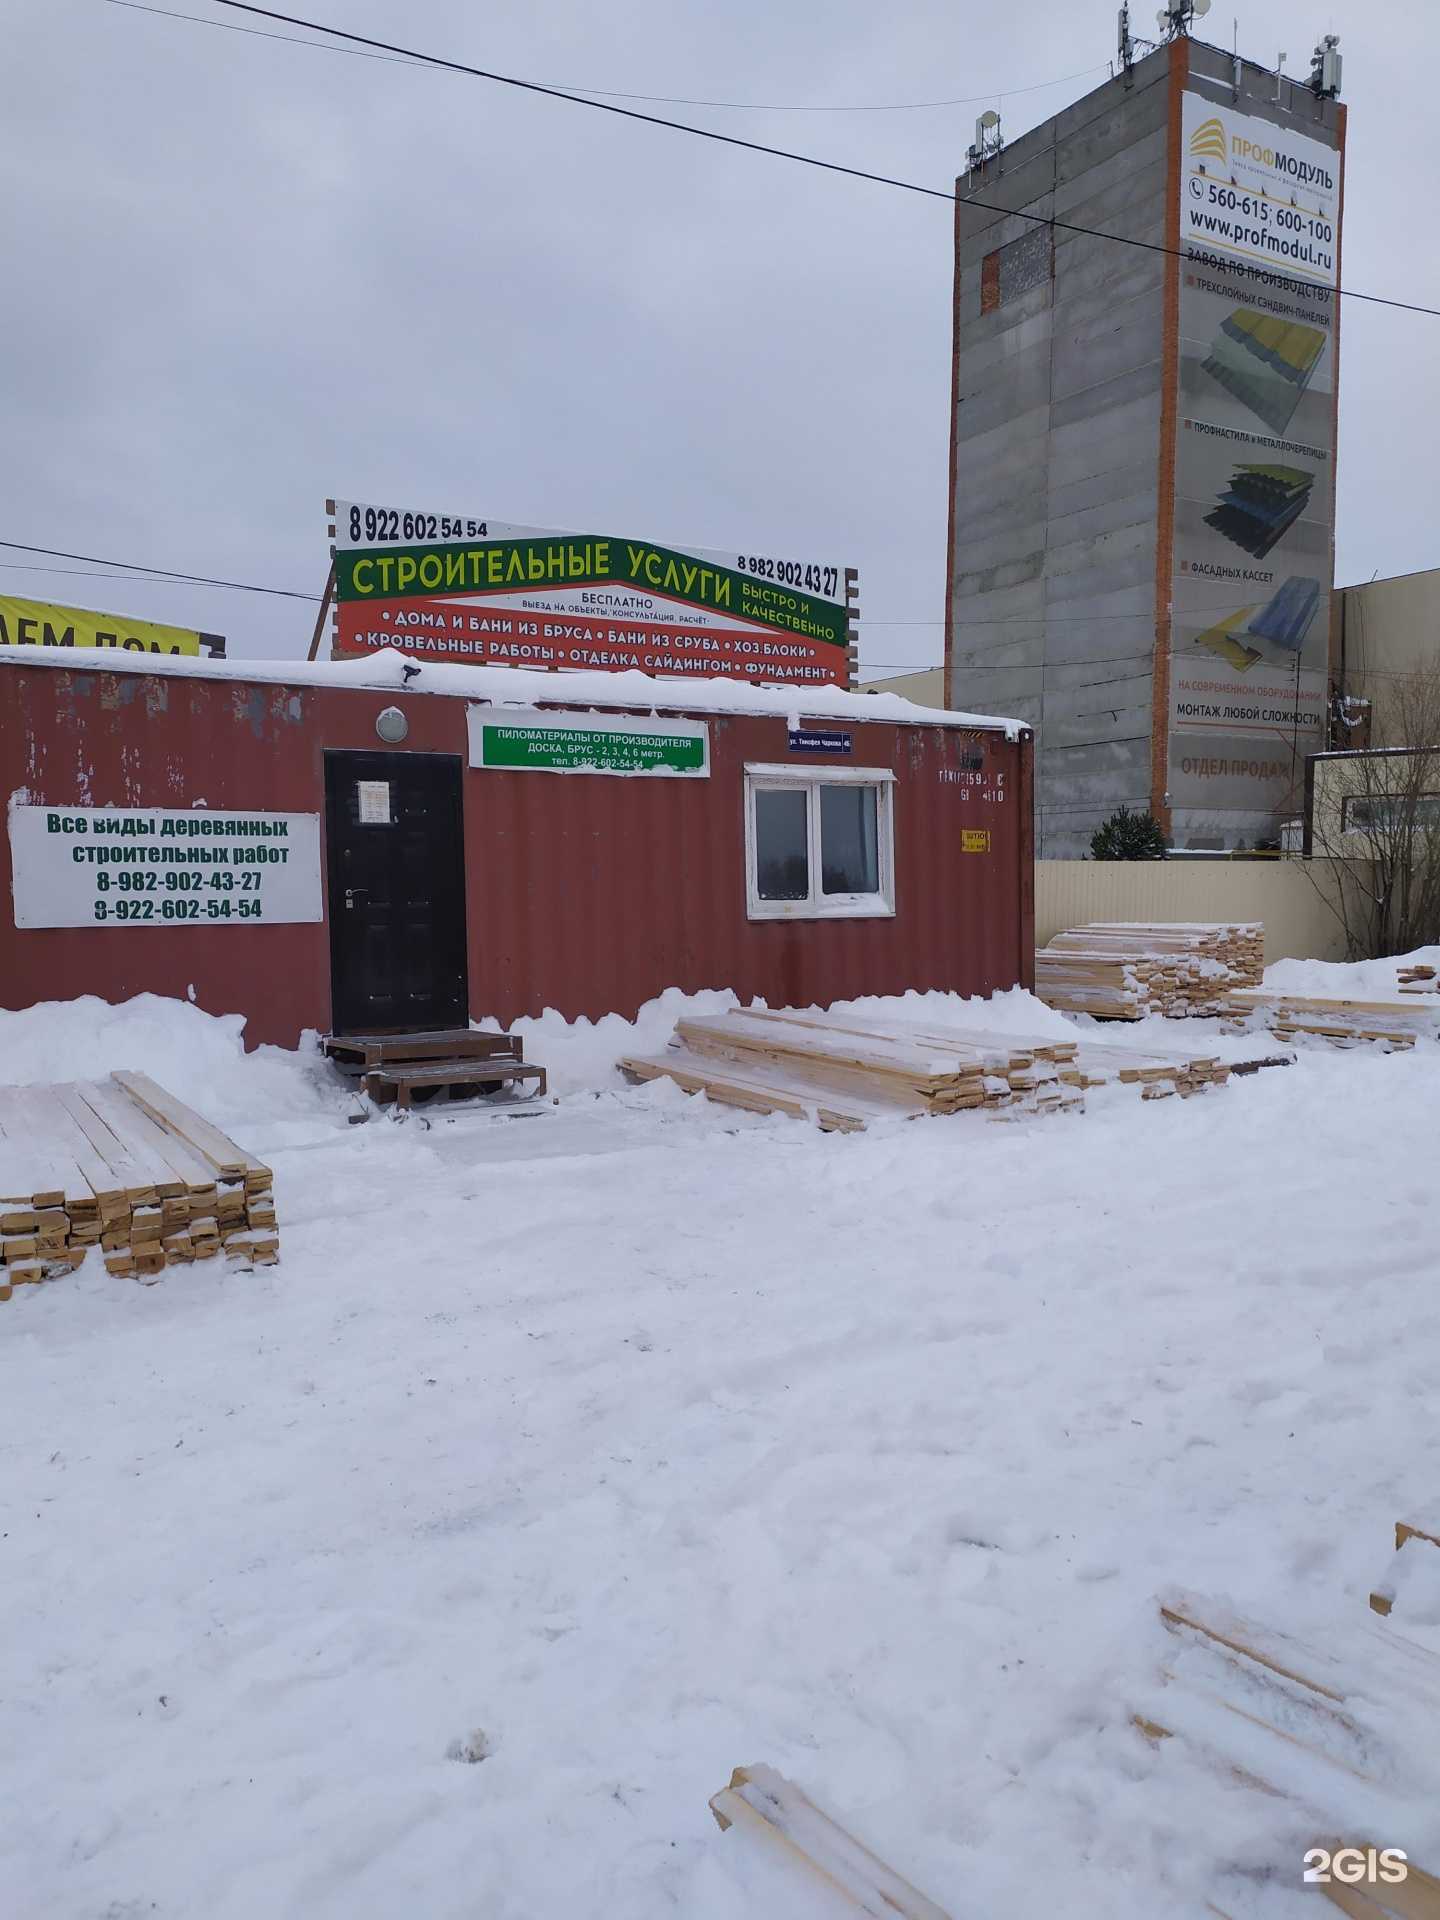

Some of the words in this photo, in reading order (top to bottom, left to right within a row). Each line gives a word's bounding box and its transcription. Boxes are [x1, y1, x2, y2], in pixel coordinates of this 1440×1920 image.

[1232, 135, 1333, 190] ПРОФМОДУЛЬ
[1208, 184, 1273, 227] 560-615;
[1277, 210, 1332, 243] 600-100
[1190, 210, 1332, 270] www.profmodul.ru
[1187, 247, 1226, 275] ЗАВОД
[1229, 260, 1245, 277] ПО
[1247, 266, 1330, 303] ПРОИЗВОДСТВУ
[1257, 296, 1330, 326] СЭНДВИЧ-ПАНЕЛЕЙ
[1194, 422, 1250, 442] ПРОФНАСТИЛА
[350, 505, 361, 542] 8
[365, 507, 399, 542] 922
[403, 512, 437, 540] 602
[441, 517, 463, 538] 54
[466, 520, 488, 537] 54
[352, 542, 609, 594] СТРОИТЕЛЬНЫЕ
[627, 544, 731, 607] УСЛУГИ
[737, 555, 746, 570] 8
[749, 557, 775, 579] 982
[777, 560, 803, 588] 902
[804, 564, 822, 594] 43
[823, 566, 838, 599] 27
[1191, 562, 1241, 579] ФАСАДНЫХ
[1242, 569, 1274, 583] КАССЕТ
[522, 600, 552, 612] ВЫЕЗД
[554, 603, 566, 613] НА
[581, 592, 654, 610] БЕСПЛАТНО
[742, 581, 797, 611] БЫСТРО
[801, 600, 810, 614] И
[741, 602, 835, 640] КАЧЕСТВЕННО
[394, 611, 447, 628] ДОМА
[452, 615, 464, 629] И
[469, 616, 513, 633] БАНИ
[518, 622, 538, 636] ИЗ
[543, 624, 593, 641] БРУСА
[607, 631, 647, 645] БАНИ
[651, 635, 670, 647] ИЗ
[674, 636, 720, 651] СРУБА
[733, 641, 808, 658] ХОЗ.БЛОКИ
[367, 631, 484, 654] КРОВЕЛЬНЫЕ
[489, 642, 554, 660] РАБОТЫ
[569, 649, 640, 666] ОТДЕЛКА
[644, 653, 732, 672] САЙДИНГОМ
[744, 661, 828, 680] ФУНДАМЕНТ
[1178, 680, 1191, 690] НА
[1191, 680, 1255, 697] СОВРЕМЕННОМ
[1177, 703, 1221, 718] МОНТАЖ
[1223, 705, 1260, 721] ЛЮБОЙ
[1262, 709, 1320, 726] СЛОЖНОСТИ
[497, 729, 590, 743] ПИЛОМАТЕРИАЛЫ
[593, 734, 606, 743] ОТ
[608, 735, 692, 748] ПРОИЗВОДИТЕЛЯ
[527, 743, 565, 755] ДОСКА,
[567, 744, 594, 754] БРУС
[633, 747, 639, 758] 6
[552, 757, 571, 766] тел.
[1182, 757, 1228, 777] ОТДЕЛ
[1231, 760, 1290, 780] ПРОДАЖ
[47, 813, 88, 834] Все
[93, 817, 155, 837] виды
[160, 818, 288, 838] деревянных
[72, 845, 229, 865] строительных
[233, 845, 289, 865] работ
[96, 871, 262, 892] 8-982-902-43-27
[94, 899, 263, 920] 8-922-602-54-54
